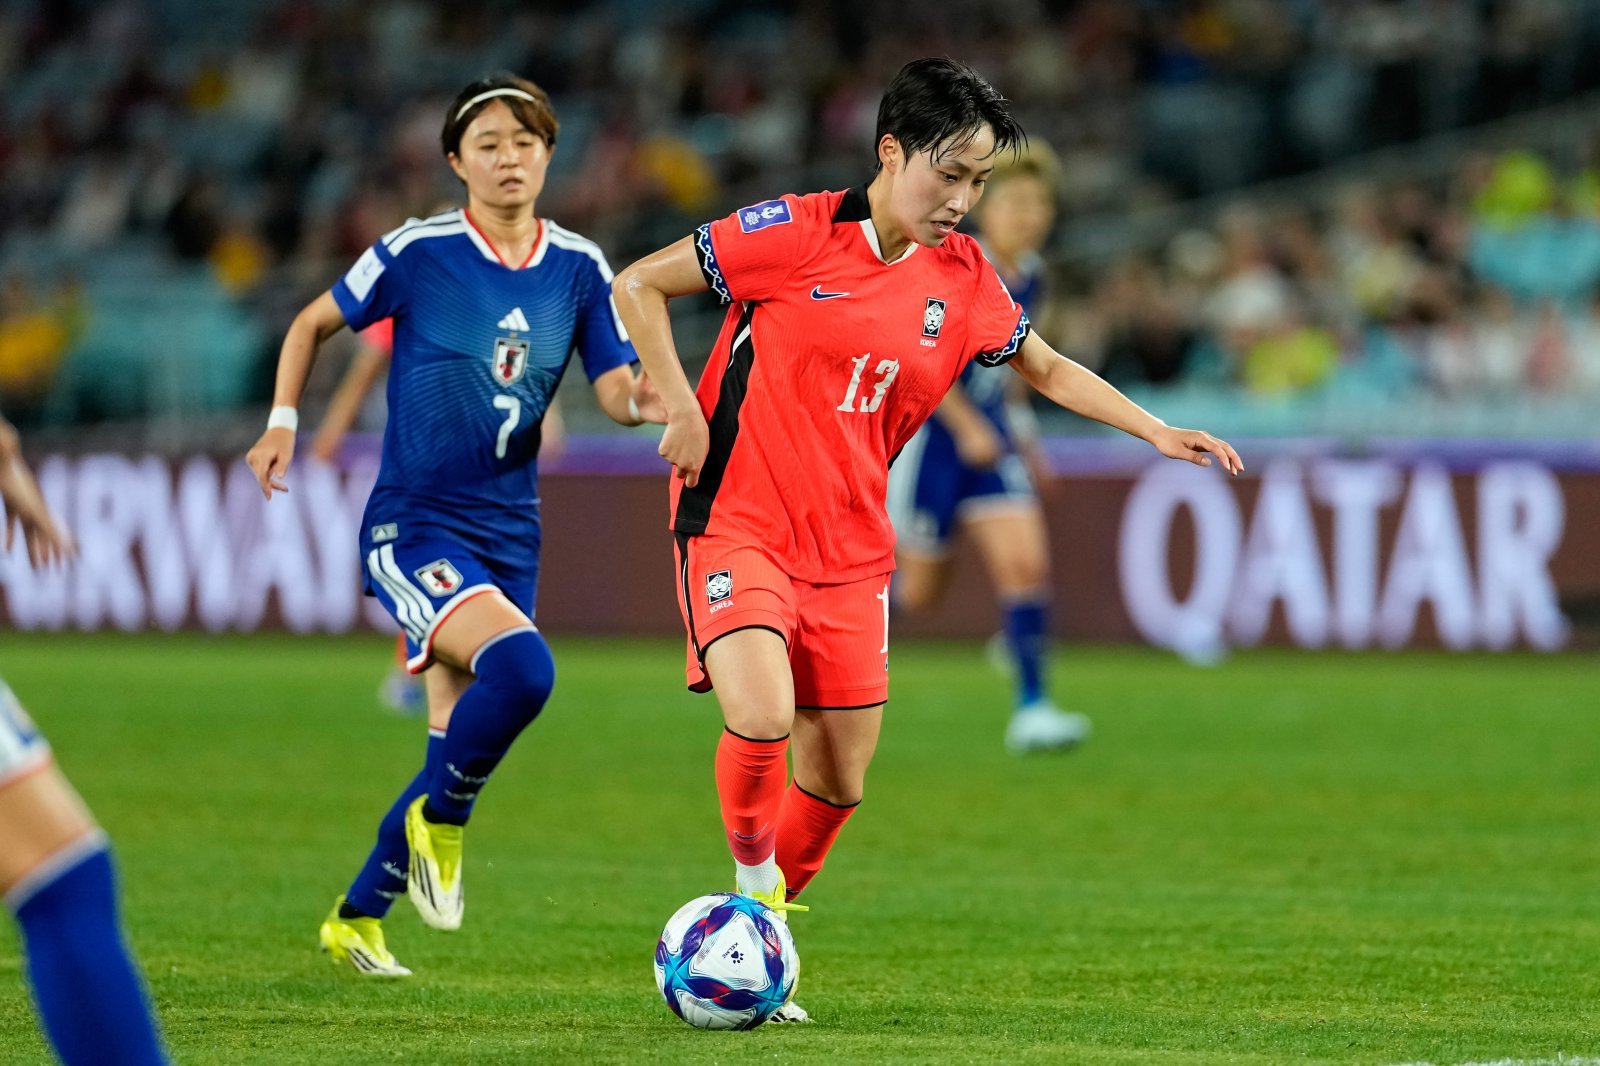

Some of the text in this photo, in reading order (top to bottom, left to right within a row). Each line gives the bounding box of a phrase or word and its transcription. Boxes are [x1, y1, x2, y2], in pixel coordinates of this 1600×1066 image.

[919, 338, 938, 348] KOREA
[836, 352, 901, 413] 13
[492, 394, 522, 460] 7
[1117, 456, 1569, 666] QATAR
[709, 599, 734, 614] KOREA
[721, 941, 739, 959] KELME
